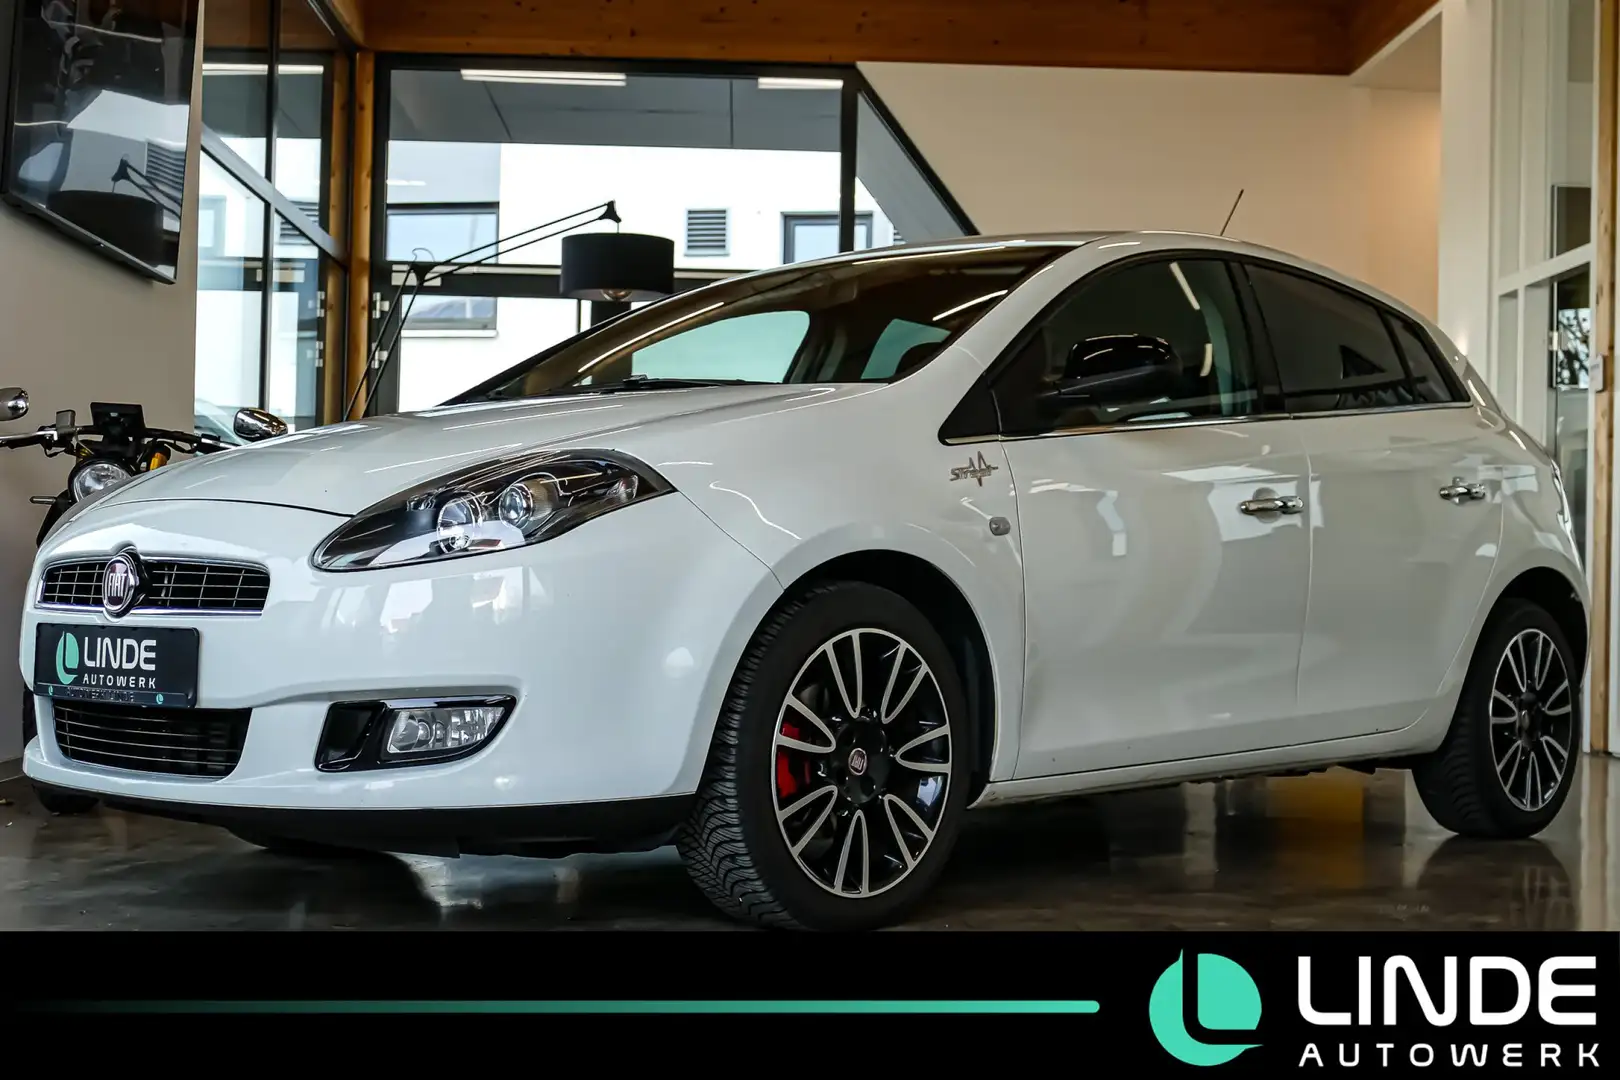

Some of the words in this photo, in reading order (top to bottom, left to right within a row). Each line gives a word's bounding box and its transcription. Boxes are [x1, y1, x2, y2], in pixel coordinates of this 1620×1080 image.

[108, 573, 127, 597] FIAT
[84, 636, 157, 671] LINDE
[83, 673, 156, 689] AUTOWERK
